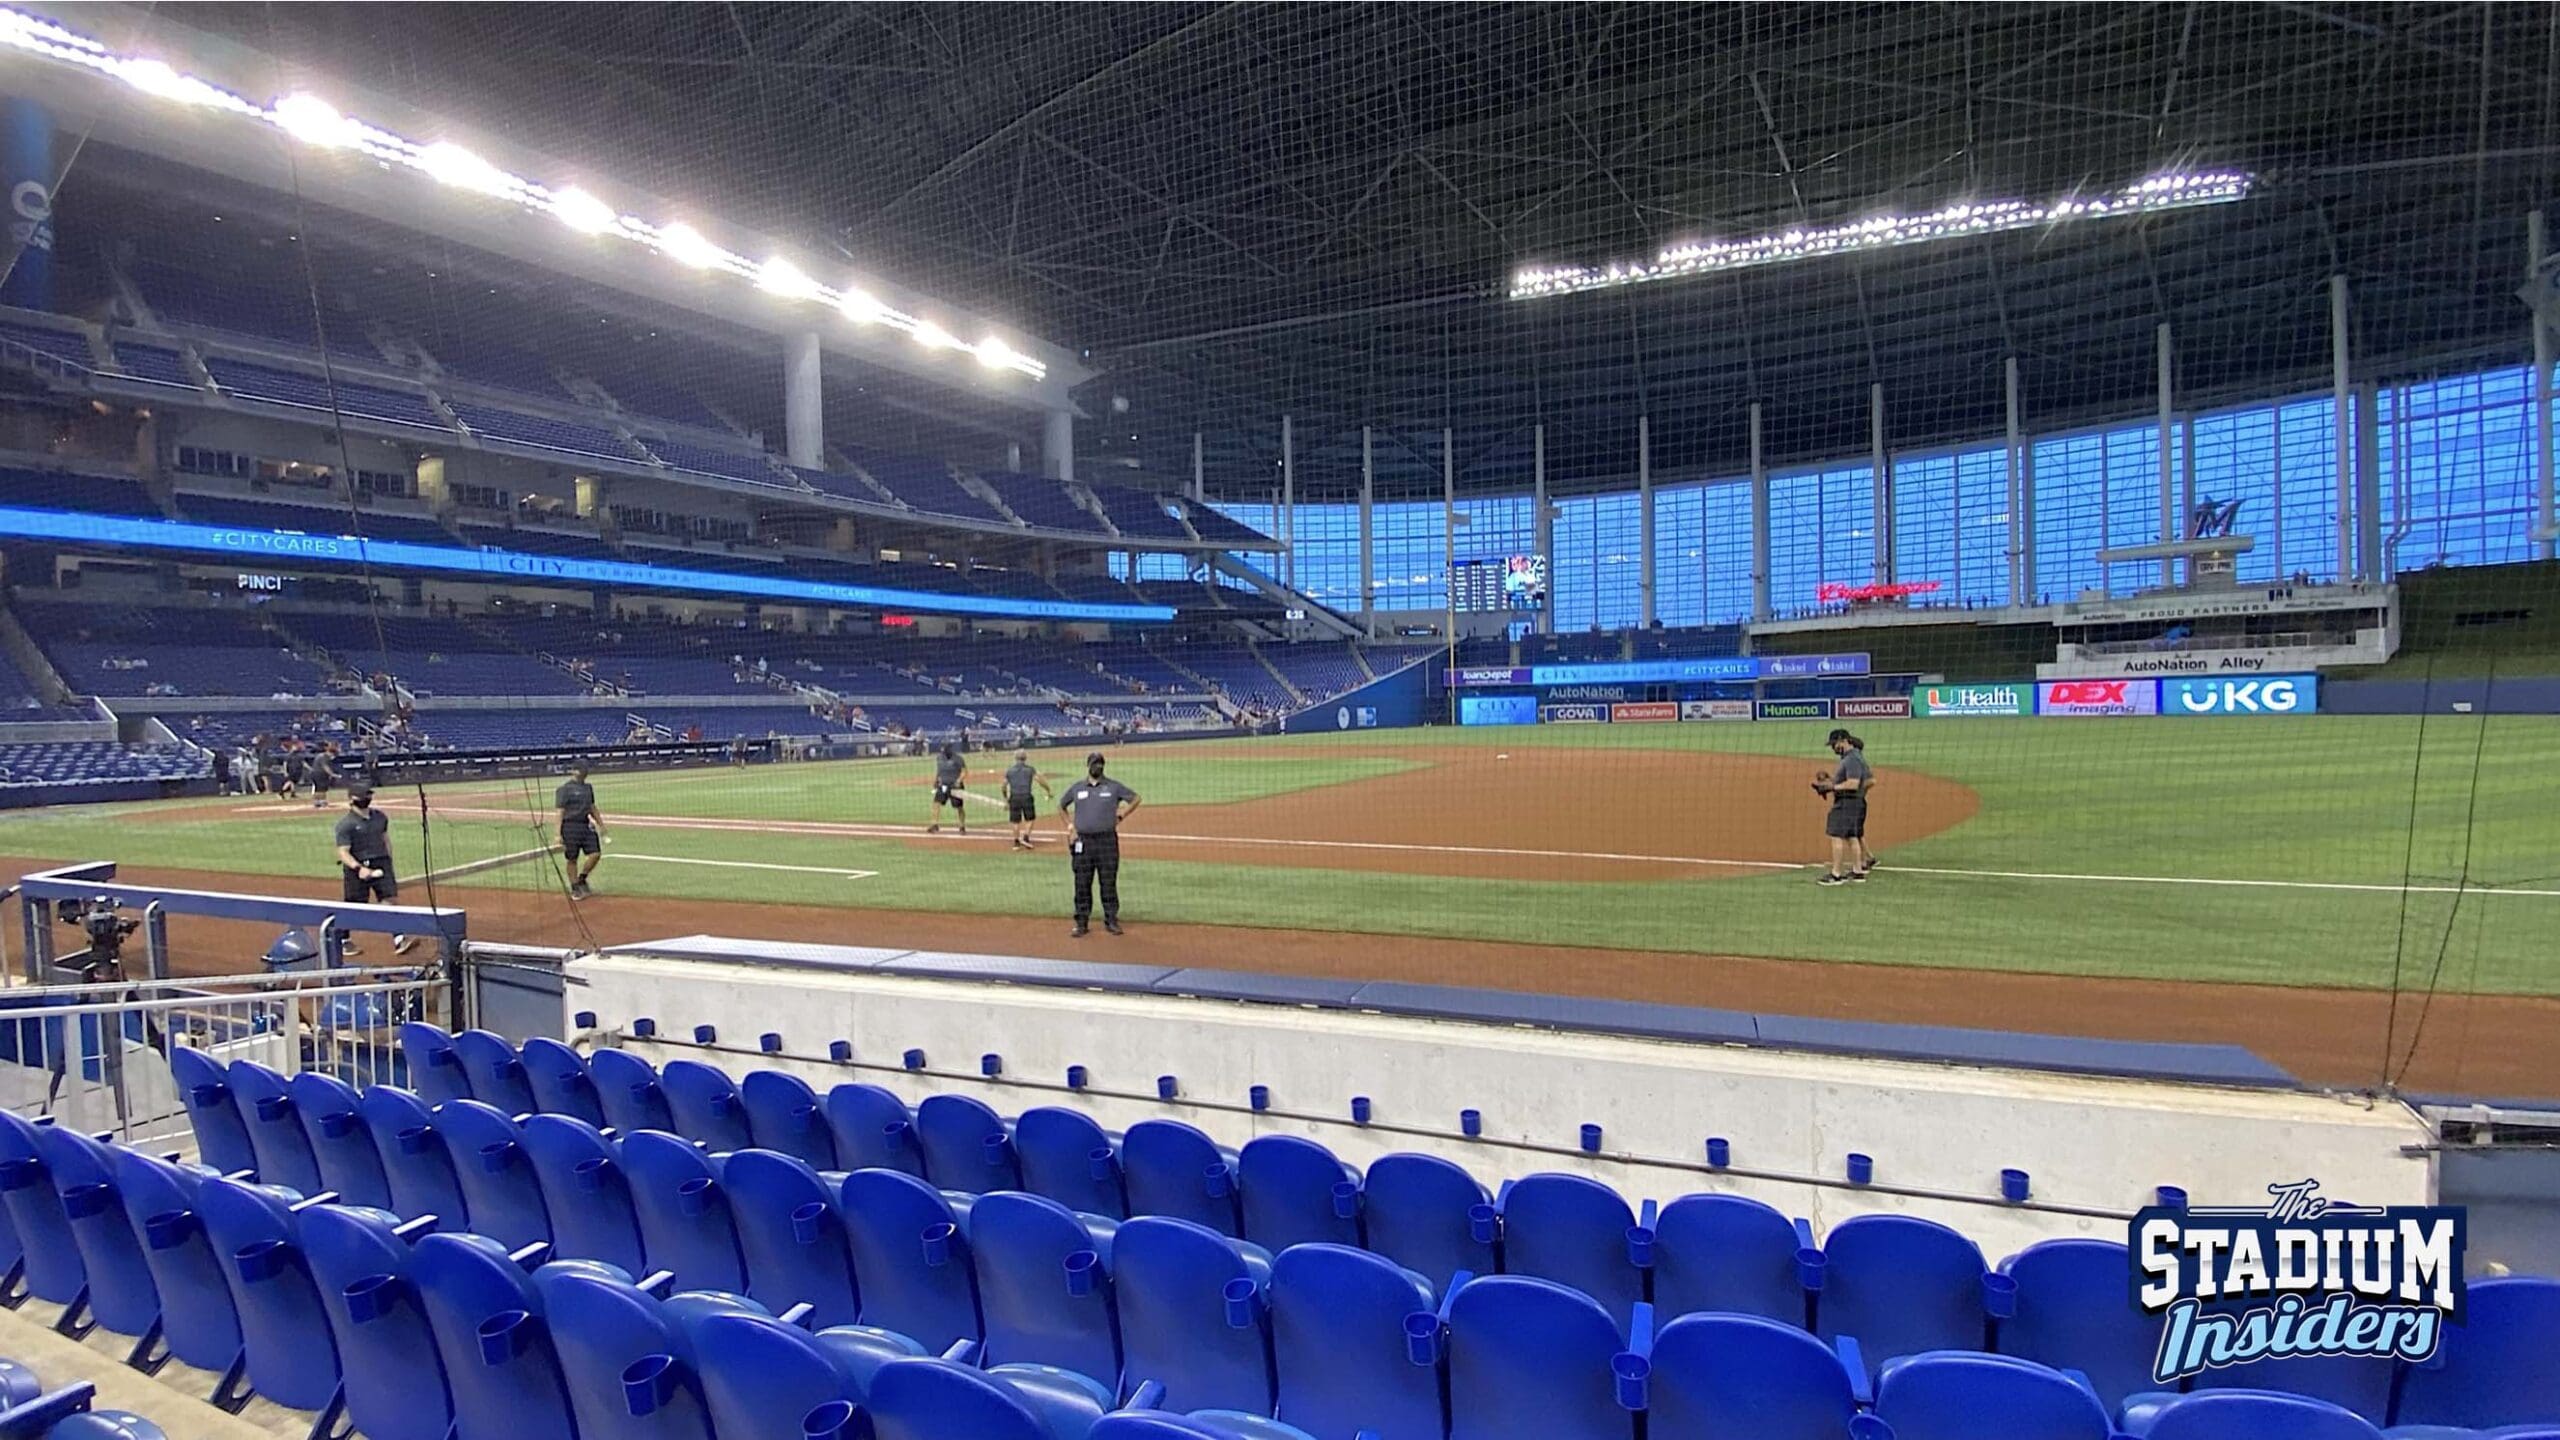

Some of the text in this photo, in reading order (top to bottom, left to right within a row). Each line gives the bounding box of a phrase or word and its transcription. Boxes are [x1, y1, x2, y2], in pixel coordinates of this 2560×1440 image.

[211, 531, 339, 555] #CITYCARES
[509, 556, 566, 575] CITY
[2140, 603, 2270, 619] PROUD PARTNERS
[1684, 663, 1750, 676] #CITYCARES
[2123, 656, 2264, 673] AutoNation Alley
[1462, 670, 1513, 680] loanDepot
[1541, 671, 1578, 681] CITY
[1548, 686, 1624, 699] AutoNation
[2049, 682, 2127, 703] DEX
[1477, 700, 1519, 711] CITY
[1764, 704, 1818, 716] Humana
[1844, 703, 1904, 714] HAIRCLUB
[2068, 703, 2137, 715] imaging
